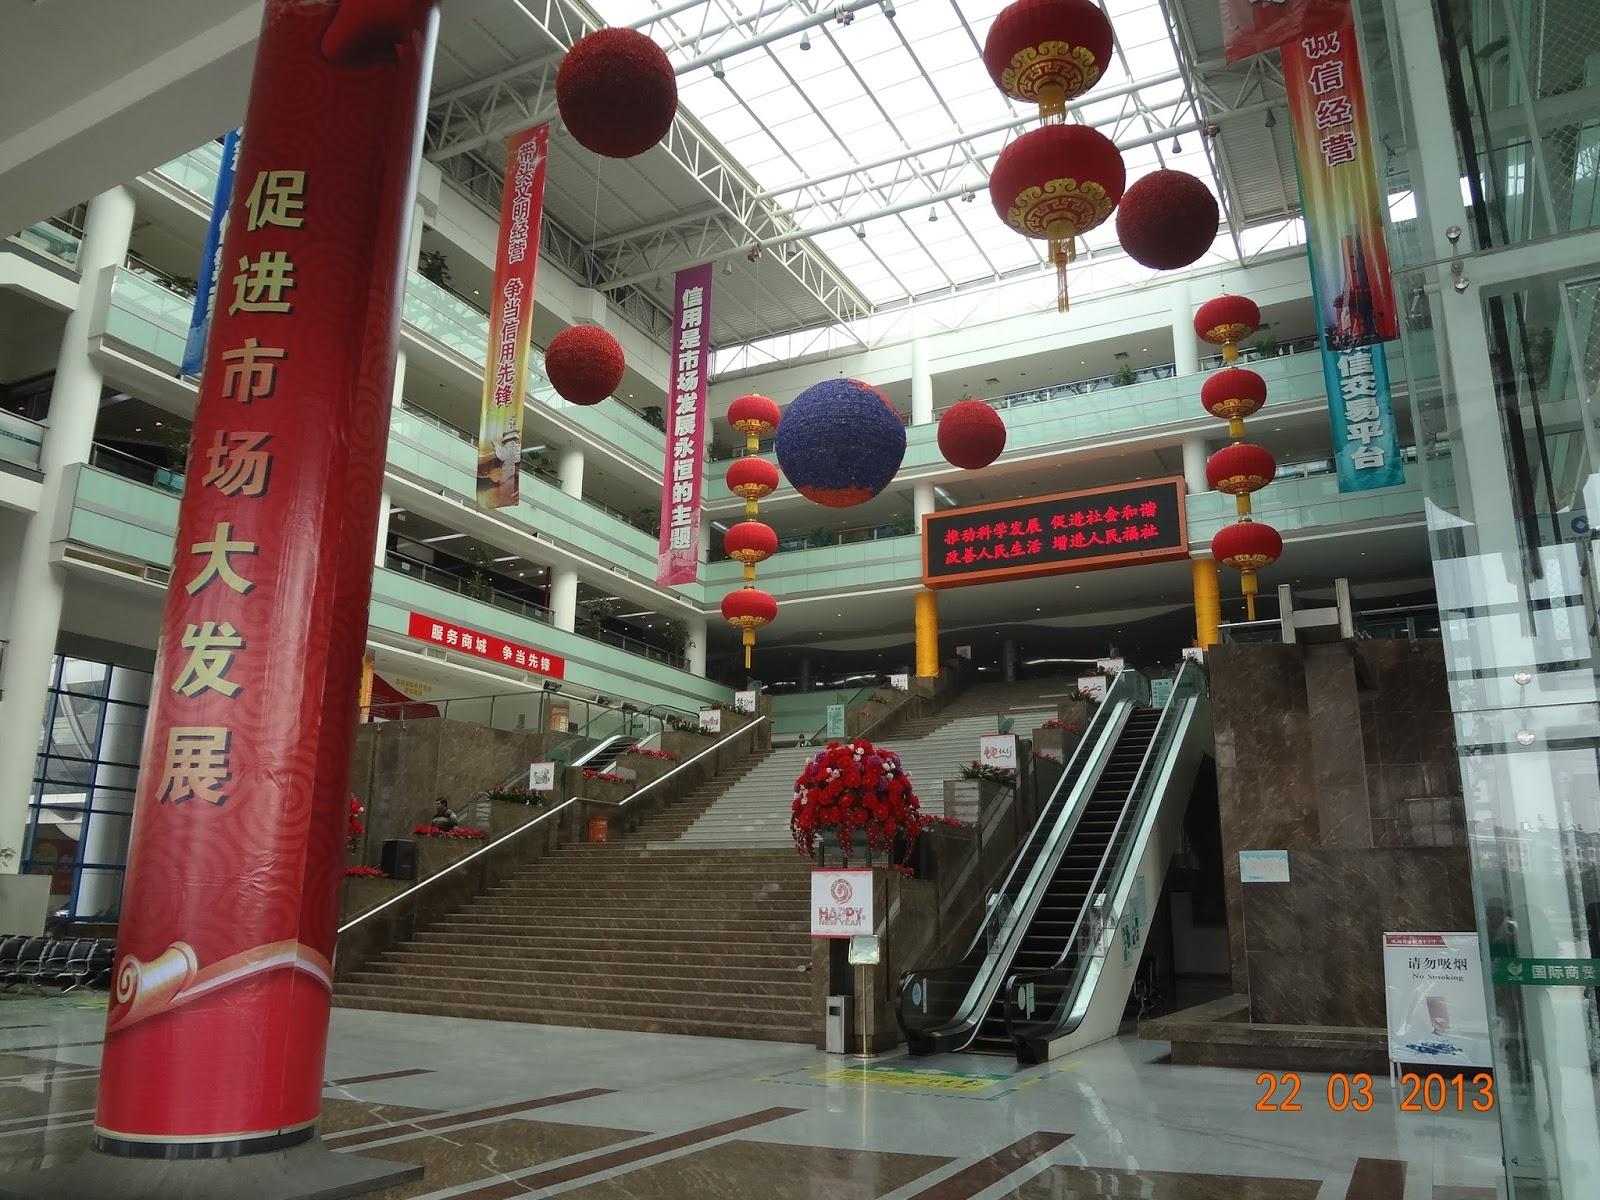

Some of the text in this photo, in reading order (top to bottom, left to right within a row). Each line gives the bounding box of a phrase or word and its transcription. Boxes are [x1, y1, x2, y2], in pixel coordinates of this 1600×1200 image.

[1302, 31, 1357, 167] 诚信经营
[494, 140, 537, 408] 带头文明经营 争当信用先锋
[670, 286, 704, 549] 信用是市场发展永恒的主题
[1337, 345, 1385, 470] 信交易平台
[155, 170, 308, 806] 促进市场大发展
[944, 501, 1159, 545] 推动科学发展 促进社会和谐
[945, 524, 1159, 565] 改善人民生活 增进人民福祉
[431, 623, 551, 672] 服务商城 争当先锋
[818, 907, 864, 920] HAPPY
[1408, 957, 1468, 971] 请勿吸烟
[1427, 973, 1464, 982] Smoking
